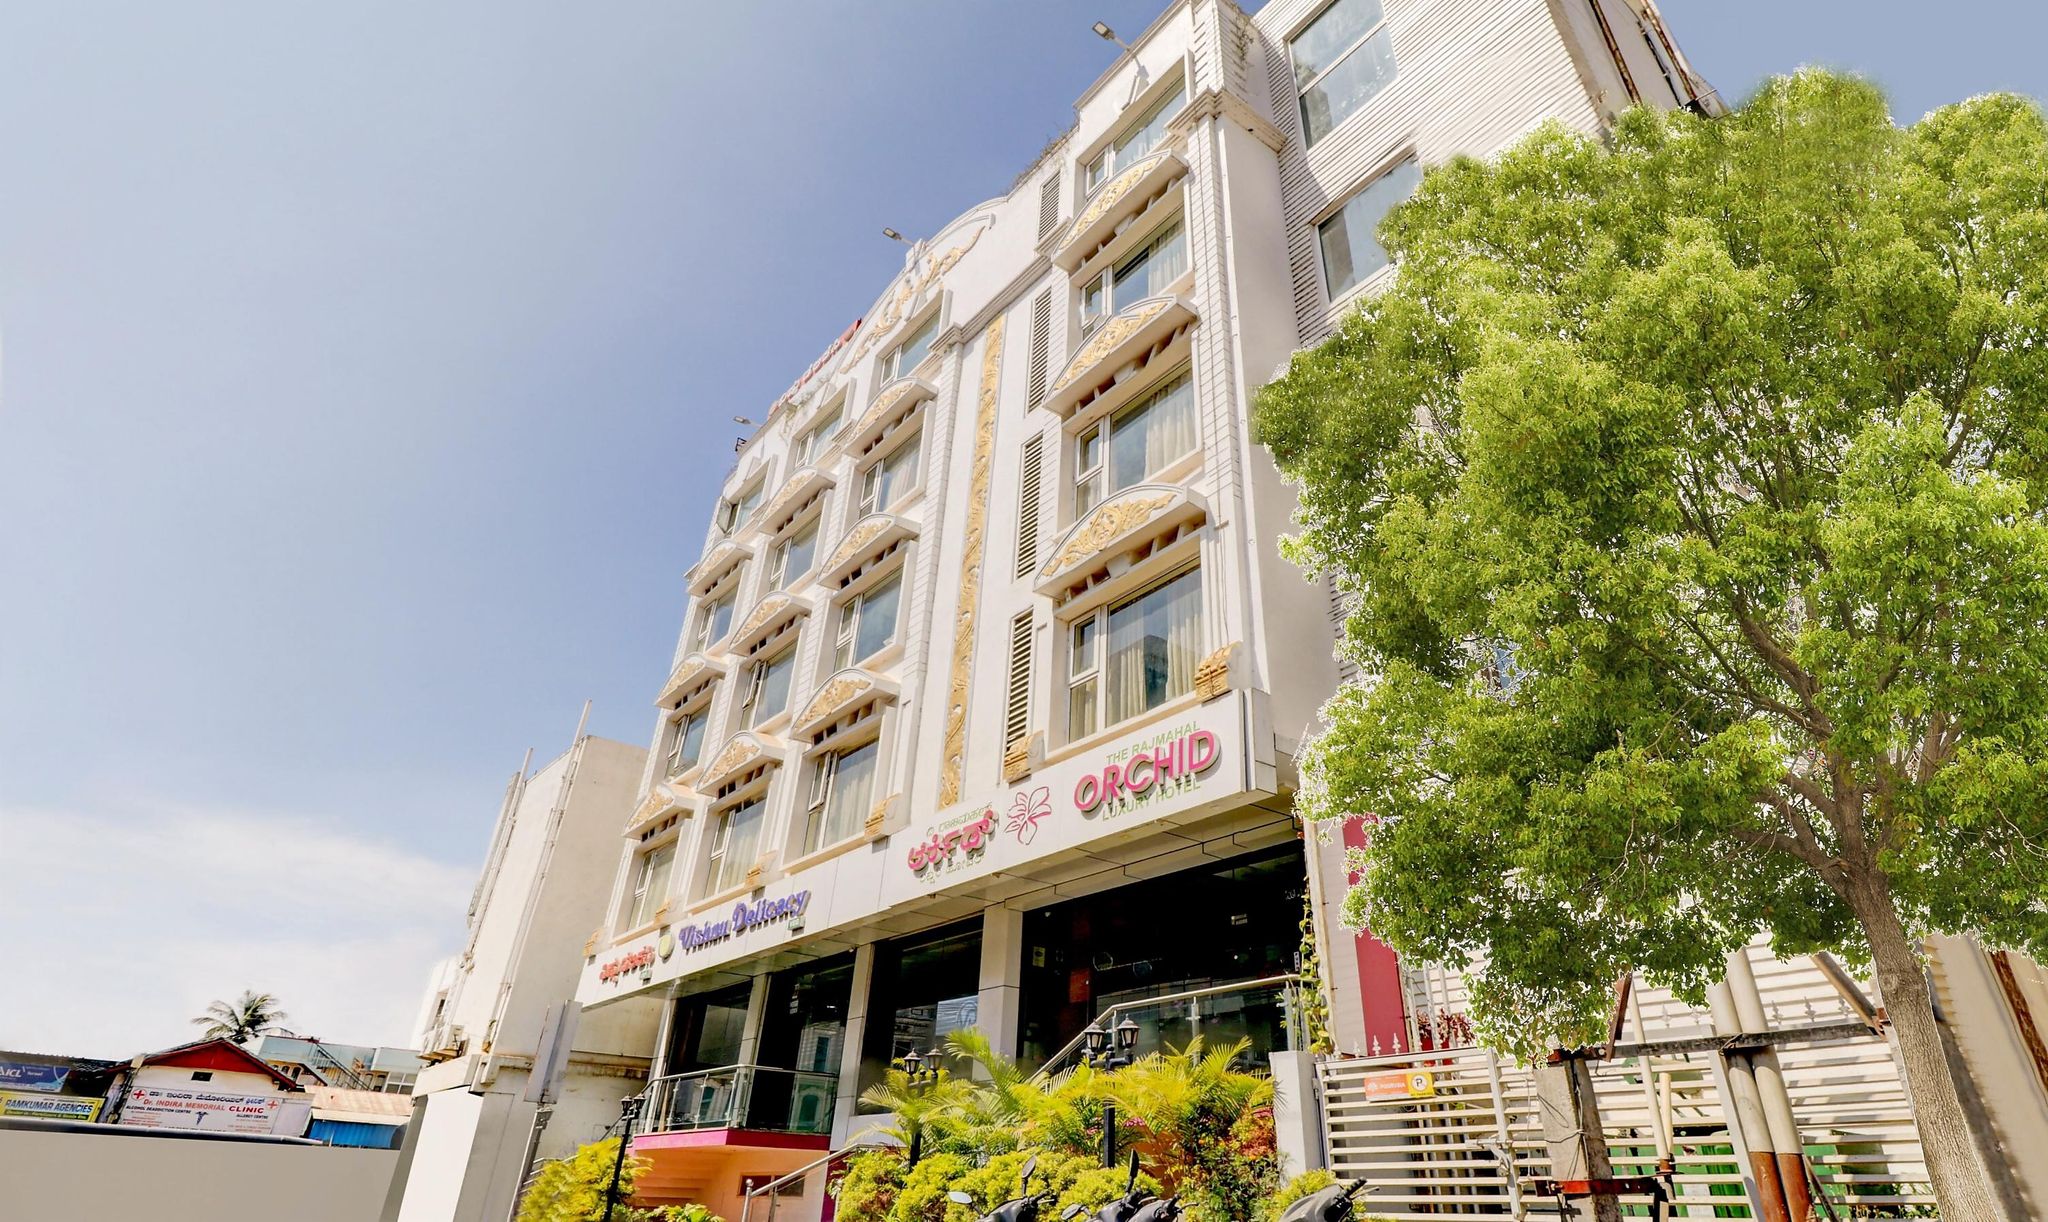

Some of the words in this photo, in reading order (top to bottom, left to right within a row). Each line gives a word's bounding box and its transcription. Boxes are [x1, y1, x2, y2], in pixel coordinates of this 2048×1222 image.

[1106, 747, 1129, 765] THE
[1131, 721, 1201, 754] RAJMAHAL
[1074, 730, 1219, 811] ORCHID
[1102, 795, 1151, 821] LUXURY
[1155, 776, 1201, 804] HOTEL
[679, 921, 730, 949] Vishnu
[732, 890, 809, 931] Delicacy
[54, 1102, 94, 1114] AGENCIES
[185, 1101, 225, 1111] MEMORIAL
[228, 1105, 264, 1114] CLINIC
